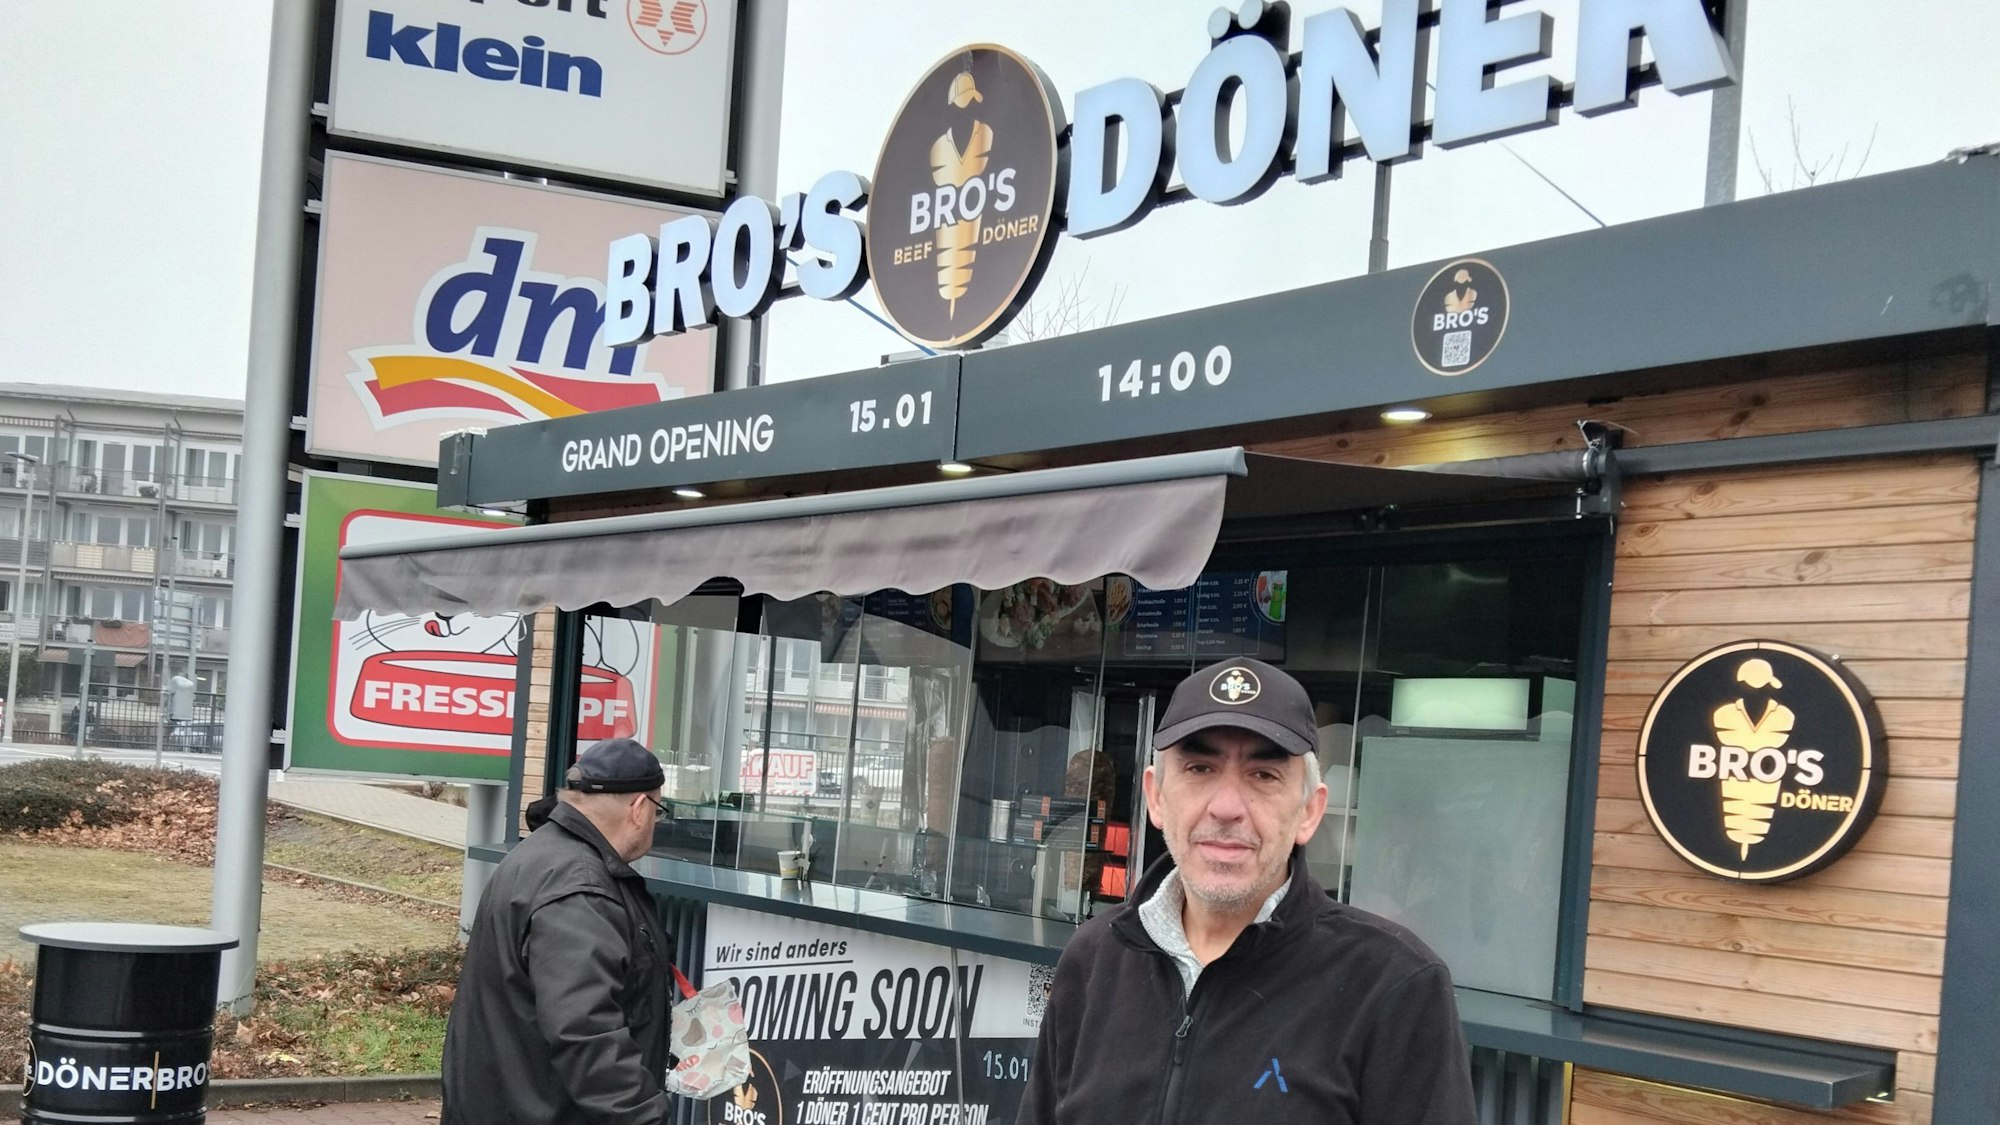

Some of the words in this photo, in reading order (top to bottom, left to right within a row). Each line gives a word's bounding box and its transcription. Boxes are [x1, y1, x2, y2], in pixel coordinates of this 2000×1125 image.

[366, 10, 603, 98] klein
[910, 168, 1017, 235] BRO'S
[603, 170, 868, 347] BRO'S
[894, 241, 933, 266] BEEF
[982, 214, 1039, 245] DÖNER
[425, 237, 640, 376] dm
[1433, 306, 1489, 331] BRO'S
[1098, 345, 1232, 402] 14:00
[562, 434, 642, 473] GRAND
[649, 414, 775, 465] OPENING
[849, 391, 933, 433] 15.01
[363, 679, 628, 727] FRESSPF
[1688, 744, 1825, 786] BRO'S
[1780, 789, 1854, 812] DÖNER
[716, 946, 742, 963] Wir
[745, 941, 782, 961] sind
[786, 938, 848, 958] anders
[729, 970, 858, 1040] OMING
[863, 964, 984, 1040] SOON
[38, 1057, 154, 1090] DÖNER
[802, 1066, 952, 1096] ERÖFFNUNGSANGEBOT
[982, 1050, 1029, 1082] 15.01
[724, 1101, 767, 1125] BRO'S
[796, 1101, 804, 1125] 1
[804, 1097, 849, 1125] DÖNER
[852, 1101, 861, 1125] 1
[861, 1102, 900, 1125] CENT
[900, 1103, 928, 1125] PRO
[930, 1103, 990, 1125] PERSON
